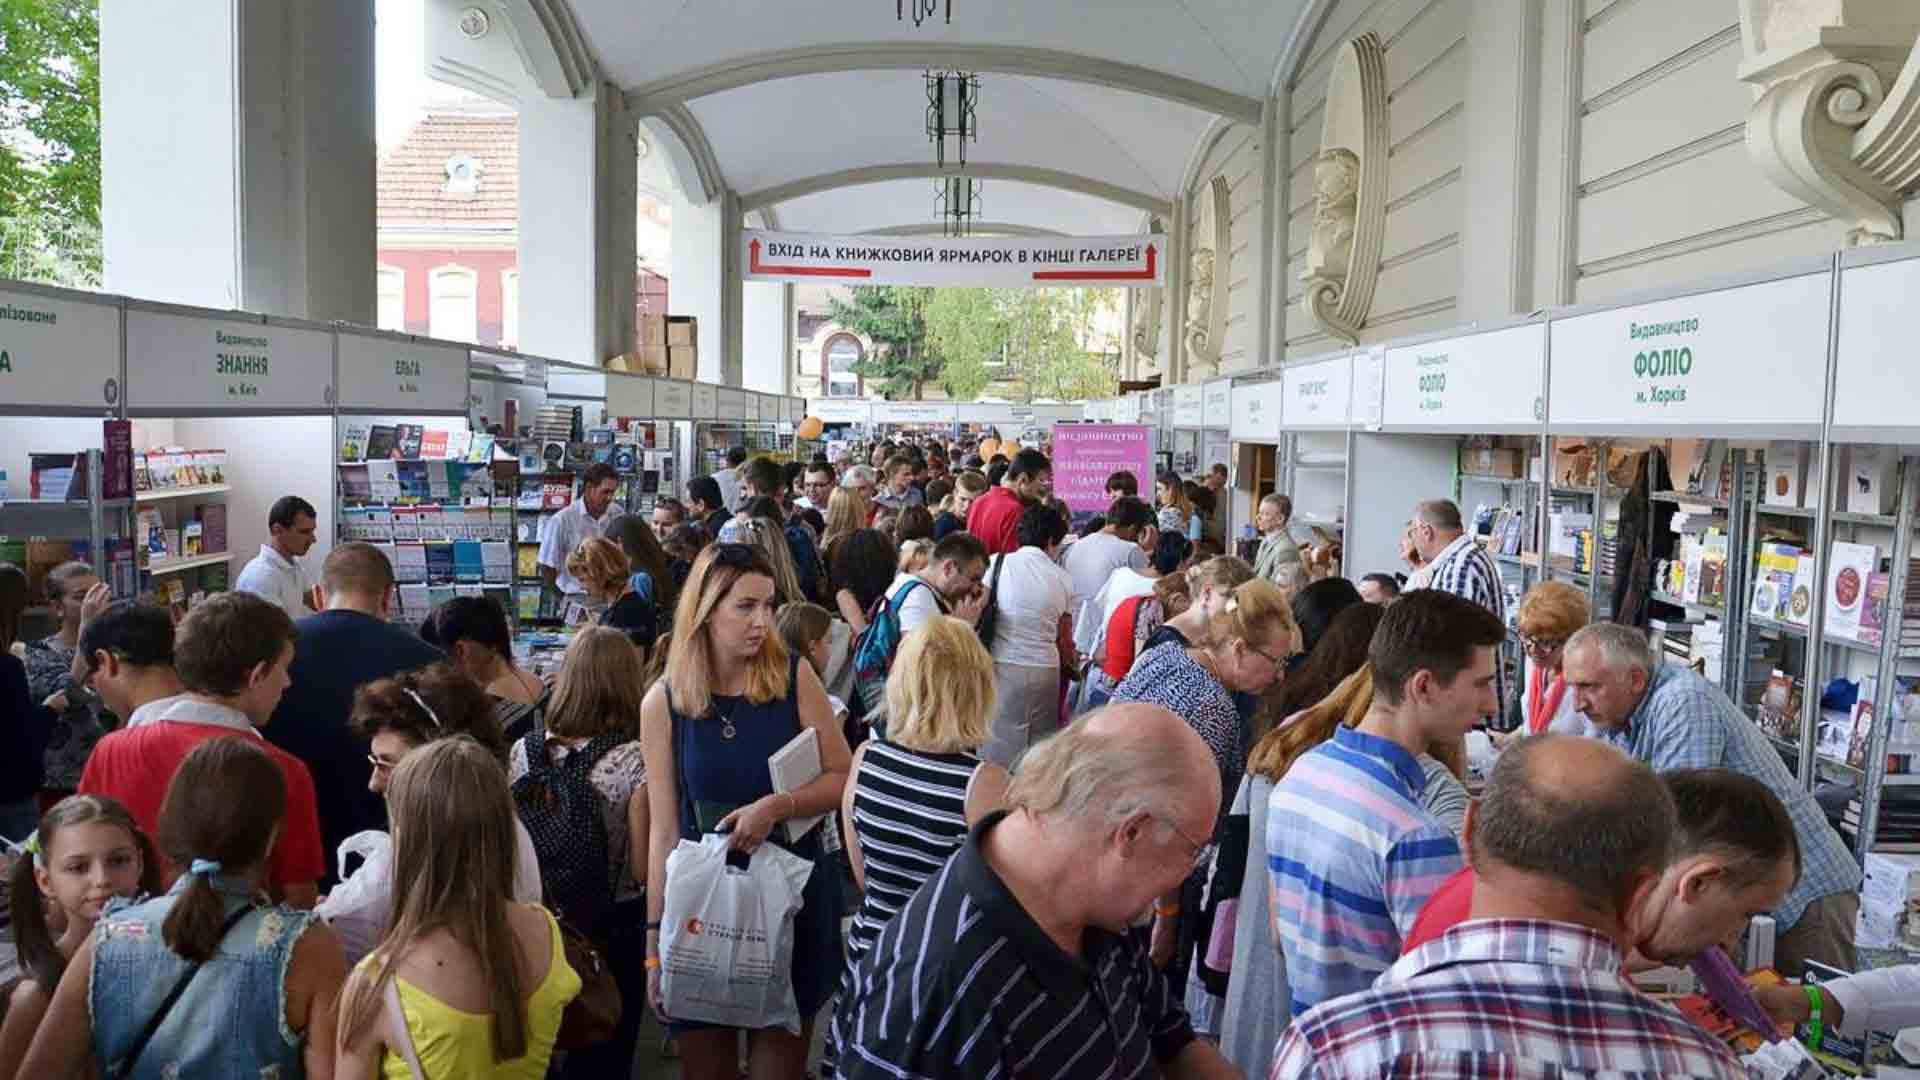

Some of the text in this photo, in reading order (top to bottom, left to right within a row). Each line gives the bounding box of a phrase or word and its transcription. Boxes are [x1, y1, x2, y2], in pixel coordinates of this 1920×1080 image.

[768, 243, 1141, 264] ВХІД НА КНИЖКОВИЙ ЯРМАРОК В КІНЦІ ГАЛЕРЕЇ
[1630, 317, 1699, 340] Видавництво
[216, 353, 268, 376] ЗНАННЯ
[1634, 347, 1692, 378] ФОЛІО
[1419, 372, 1447, 393] ФОЛІО
[1636, 384, 1687, 407] м. Харків
